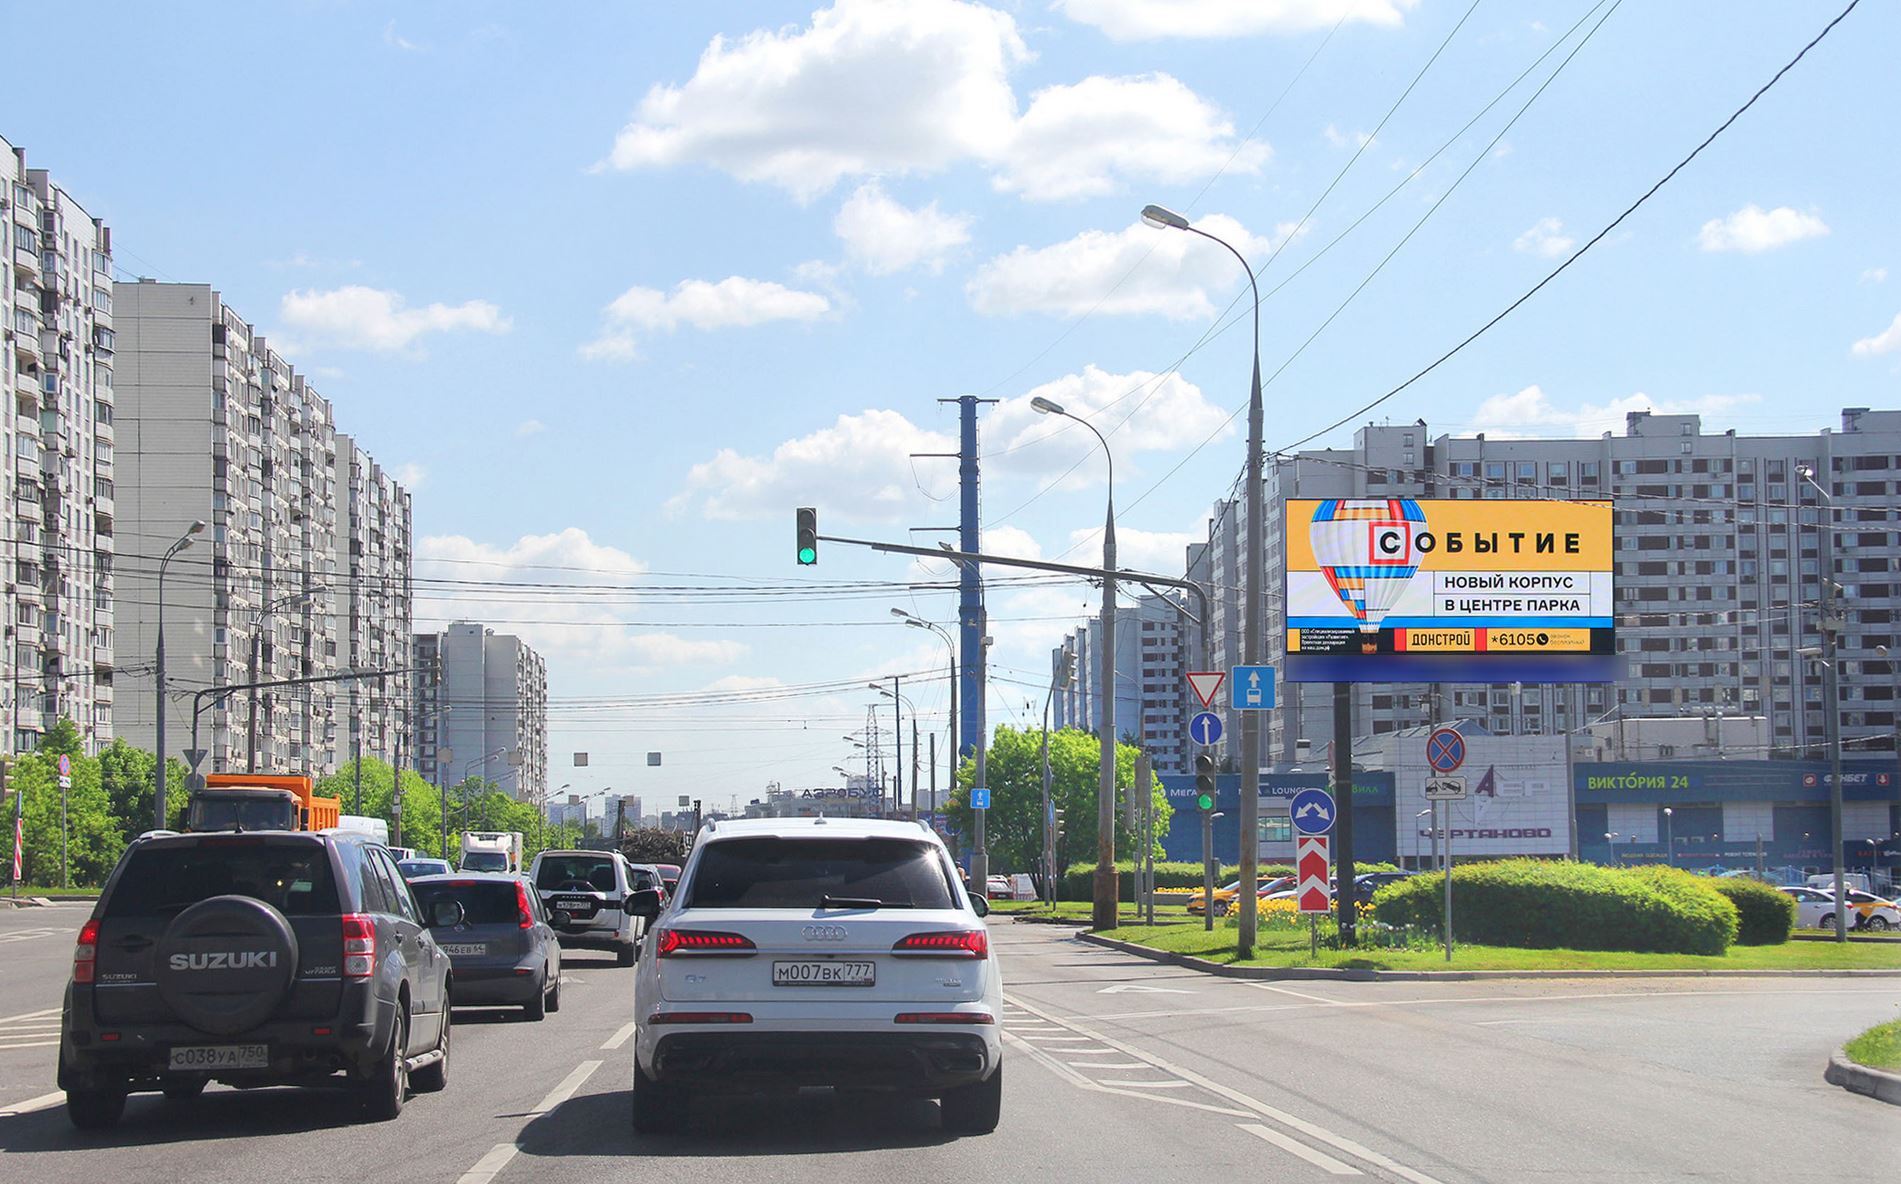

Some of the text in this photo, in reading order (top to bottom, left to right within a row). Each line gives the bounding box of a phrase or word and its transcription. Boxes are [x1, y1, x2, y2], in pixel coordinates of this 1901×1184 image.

[1379, 531, 1580, 554] СОБЫТИЕ
[1444, 573, 1573, 589] НОВЫЙ КОРПУС
[1445, 599, 1580, 613] В ЦЕНТРЕ ПАРКА
[1411, 631, 1470, 646] ДОНСТРОЙ
[1671, 776, 1688, 790] 24
[1823, 773, 1867, 783] ФНБЕТ
[169, 951, 277, 970] SUZUKI
[778, 963, 870, 980] М007ВК 777
[174, 1045, 264, 1066] С038УА 750
